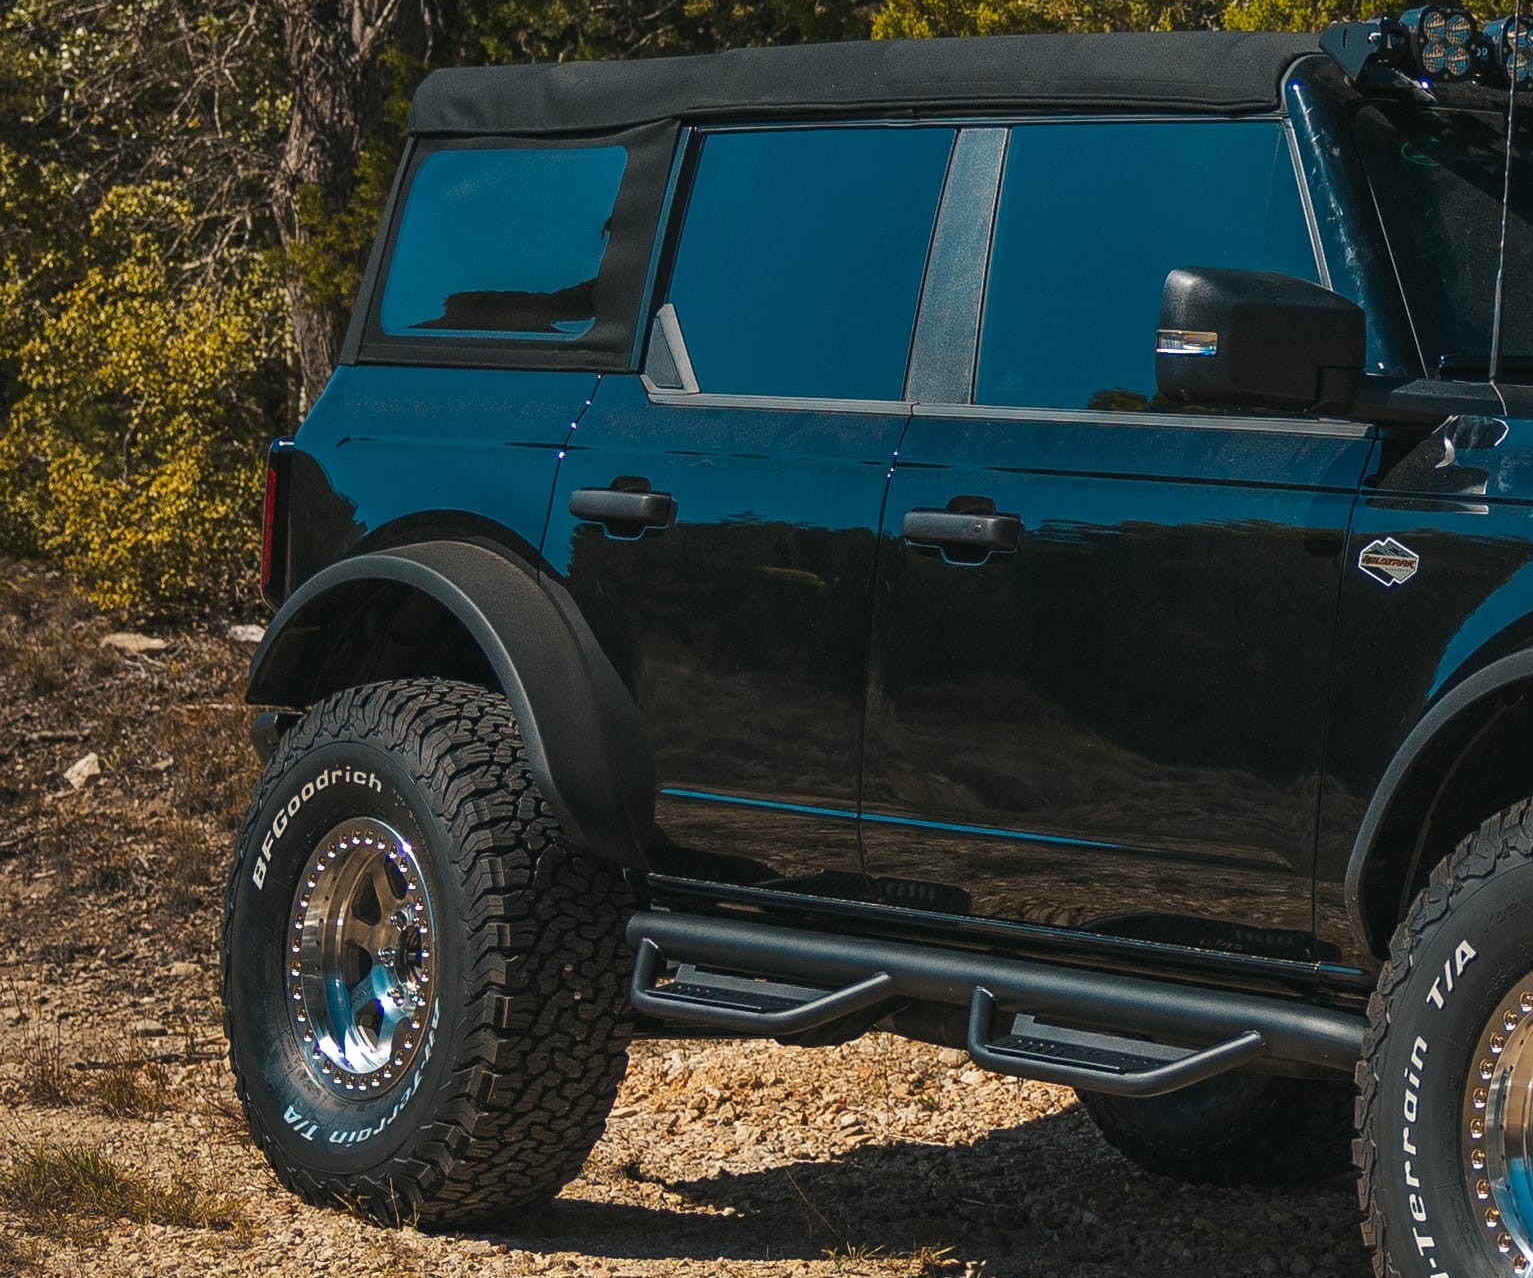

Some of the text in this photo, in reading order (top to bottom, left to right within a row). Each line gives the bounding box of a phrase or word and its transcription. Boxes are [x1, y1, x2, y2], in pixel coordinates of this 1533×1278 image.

[252, 766, 382, 890] BFGoodrich
[1426, 939, 1476, 1010] T/A
[283, 1105, 322, 1141] T/A
